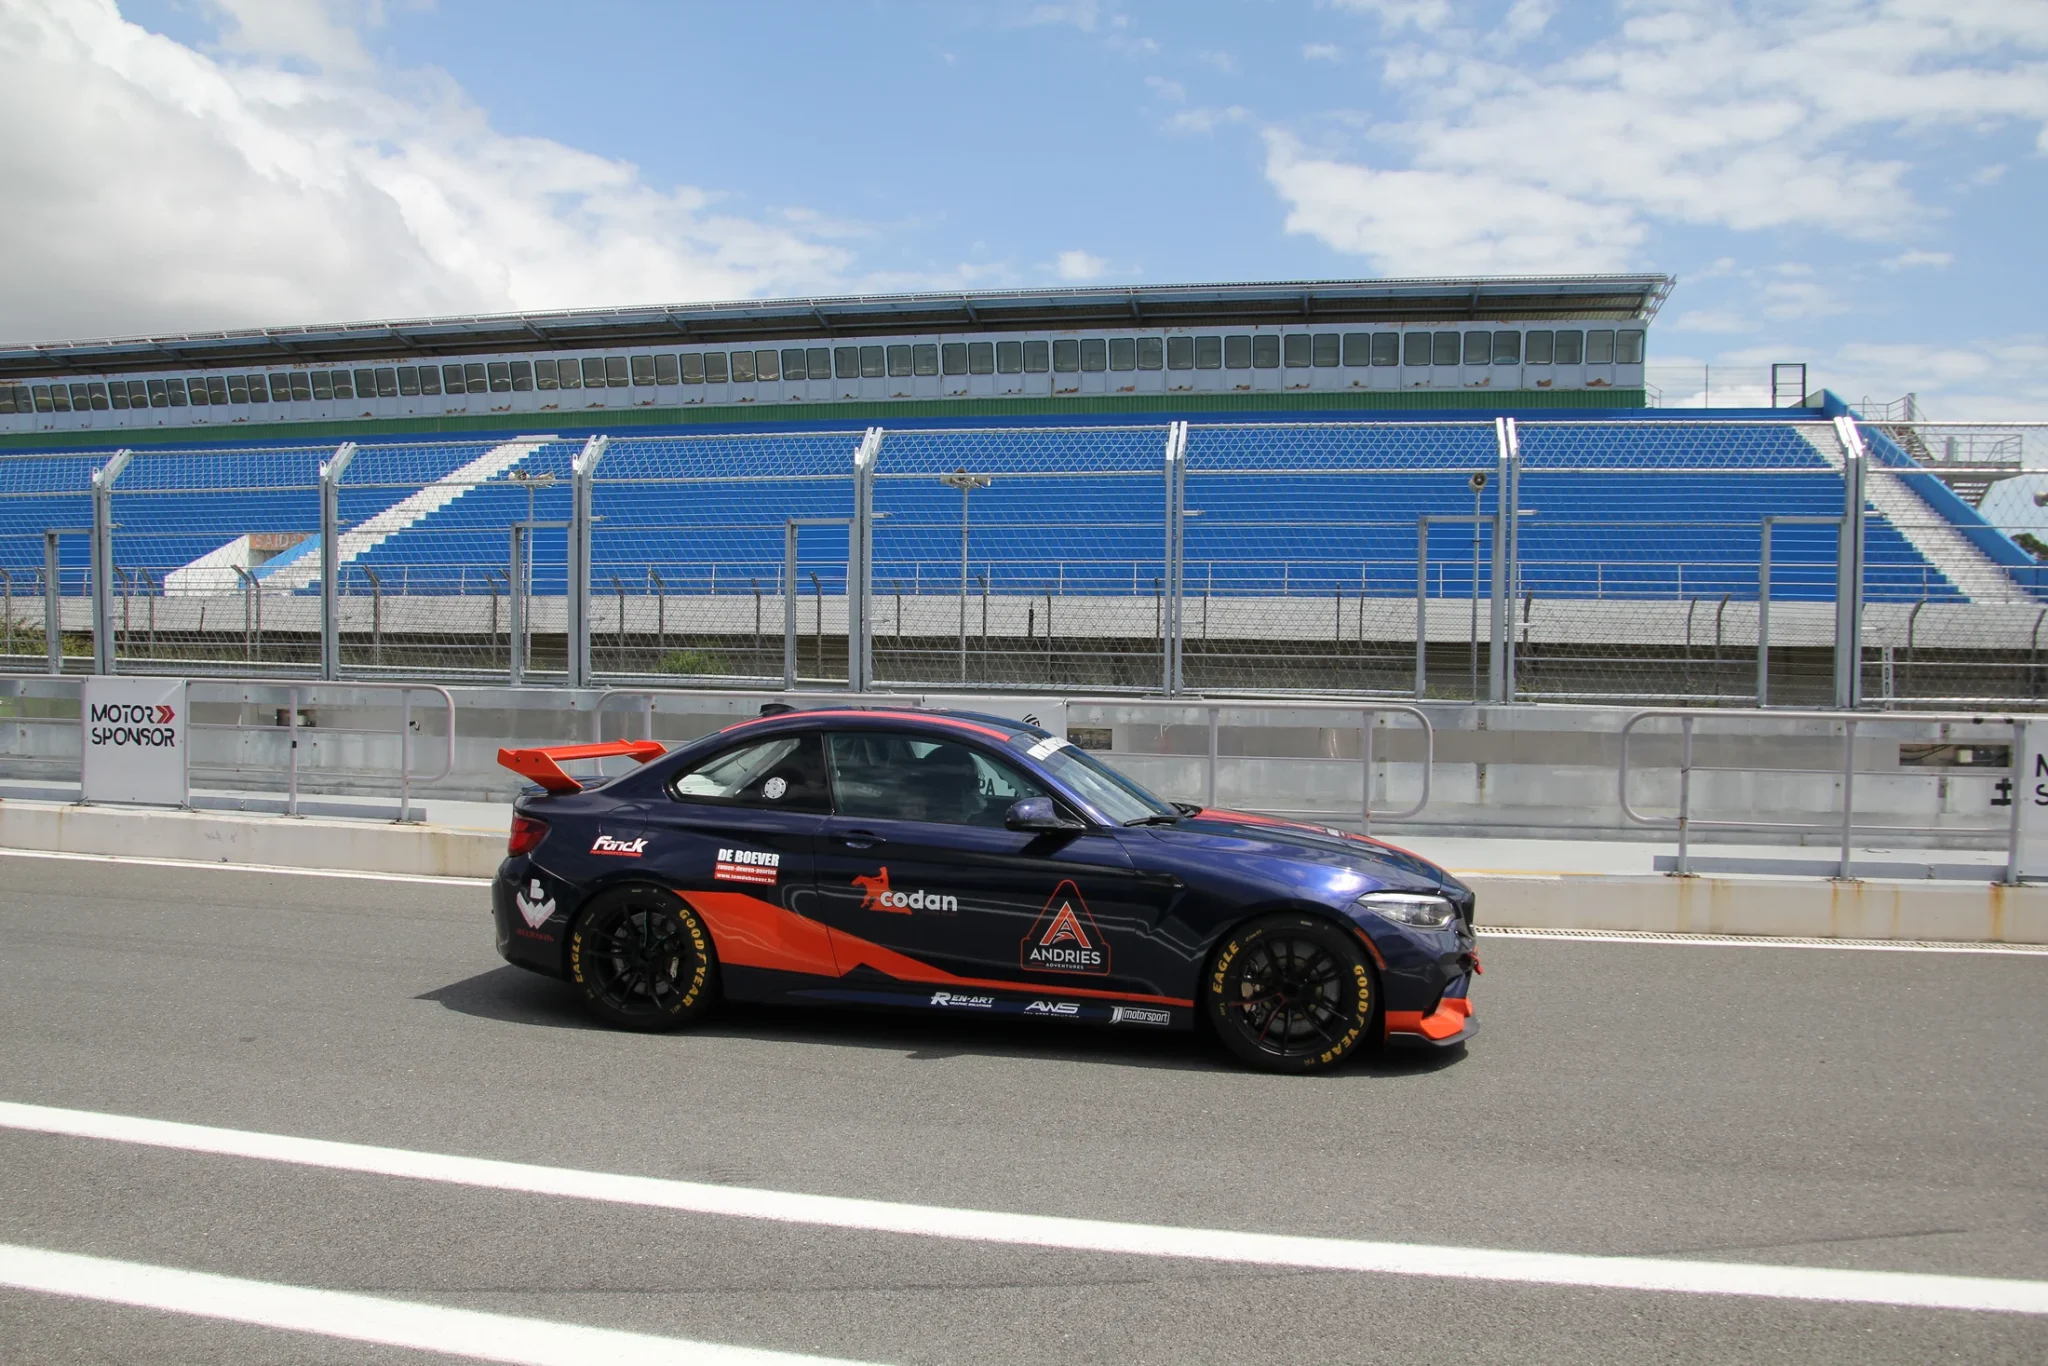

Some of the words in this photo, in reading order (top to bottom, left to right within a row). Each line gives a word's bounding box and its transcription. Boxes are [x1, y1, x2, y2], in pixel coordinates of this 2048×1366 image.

[91, 704, 155, 724] MOTOR
[91, 727, 175, 747] SPONSOR
[717, 848, 734, 862] DE
[734, 850, 780, 867] BOEVER
[880, 889, 958, 912] codan
[571, 931, 584, 983] EAGLE
[1029, 947, 1101, 965] ANDRIES
[1045, 962, 1085, 970] ADVENTURES
[1212, 940, 1240, 994] EAGLE
[1024, 1000, 1081, 1014] AWS
[1124, 1009, 1168, 1023] motorsport
[1320, 964, 1369, 1063] GOODYEAR
